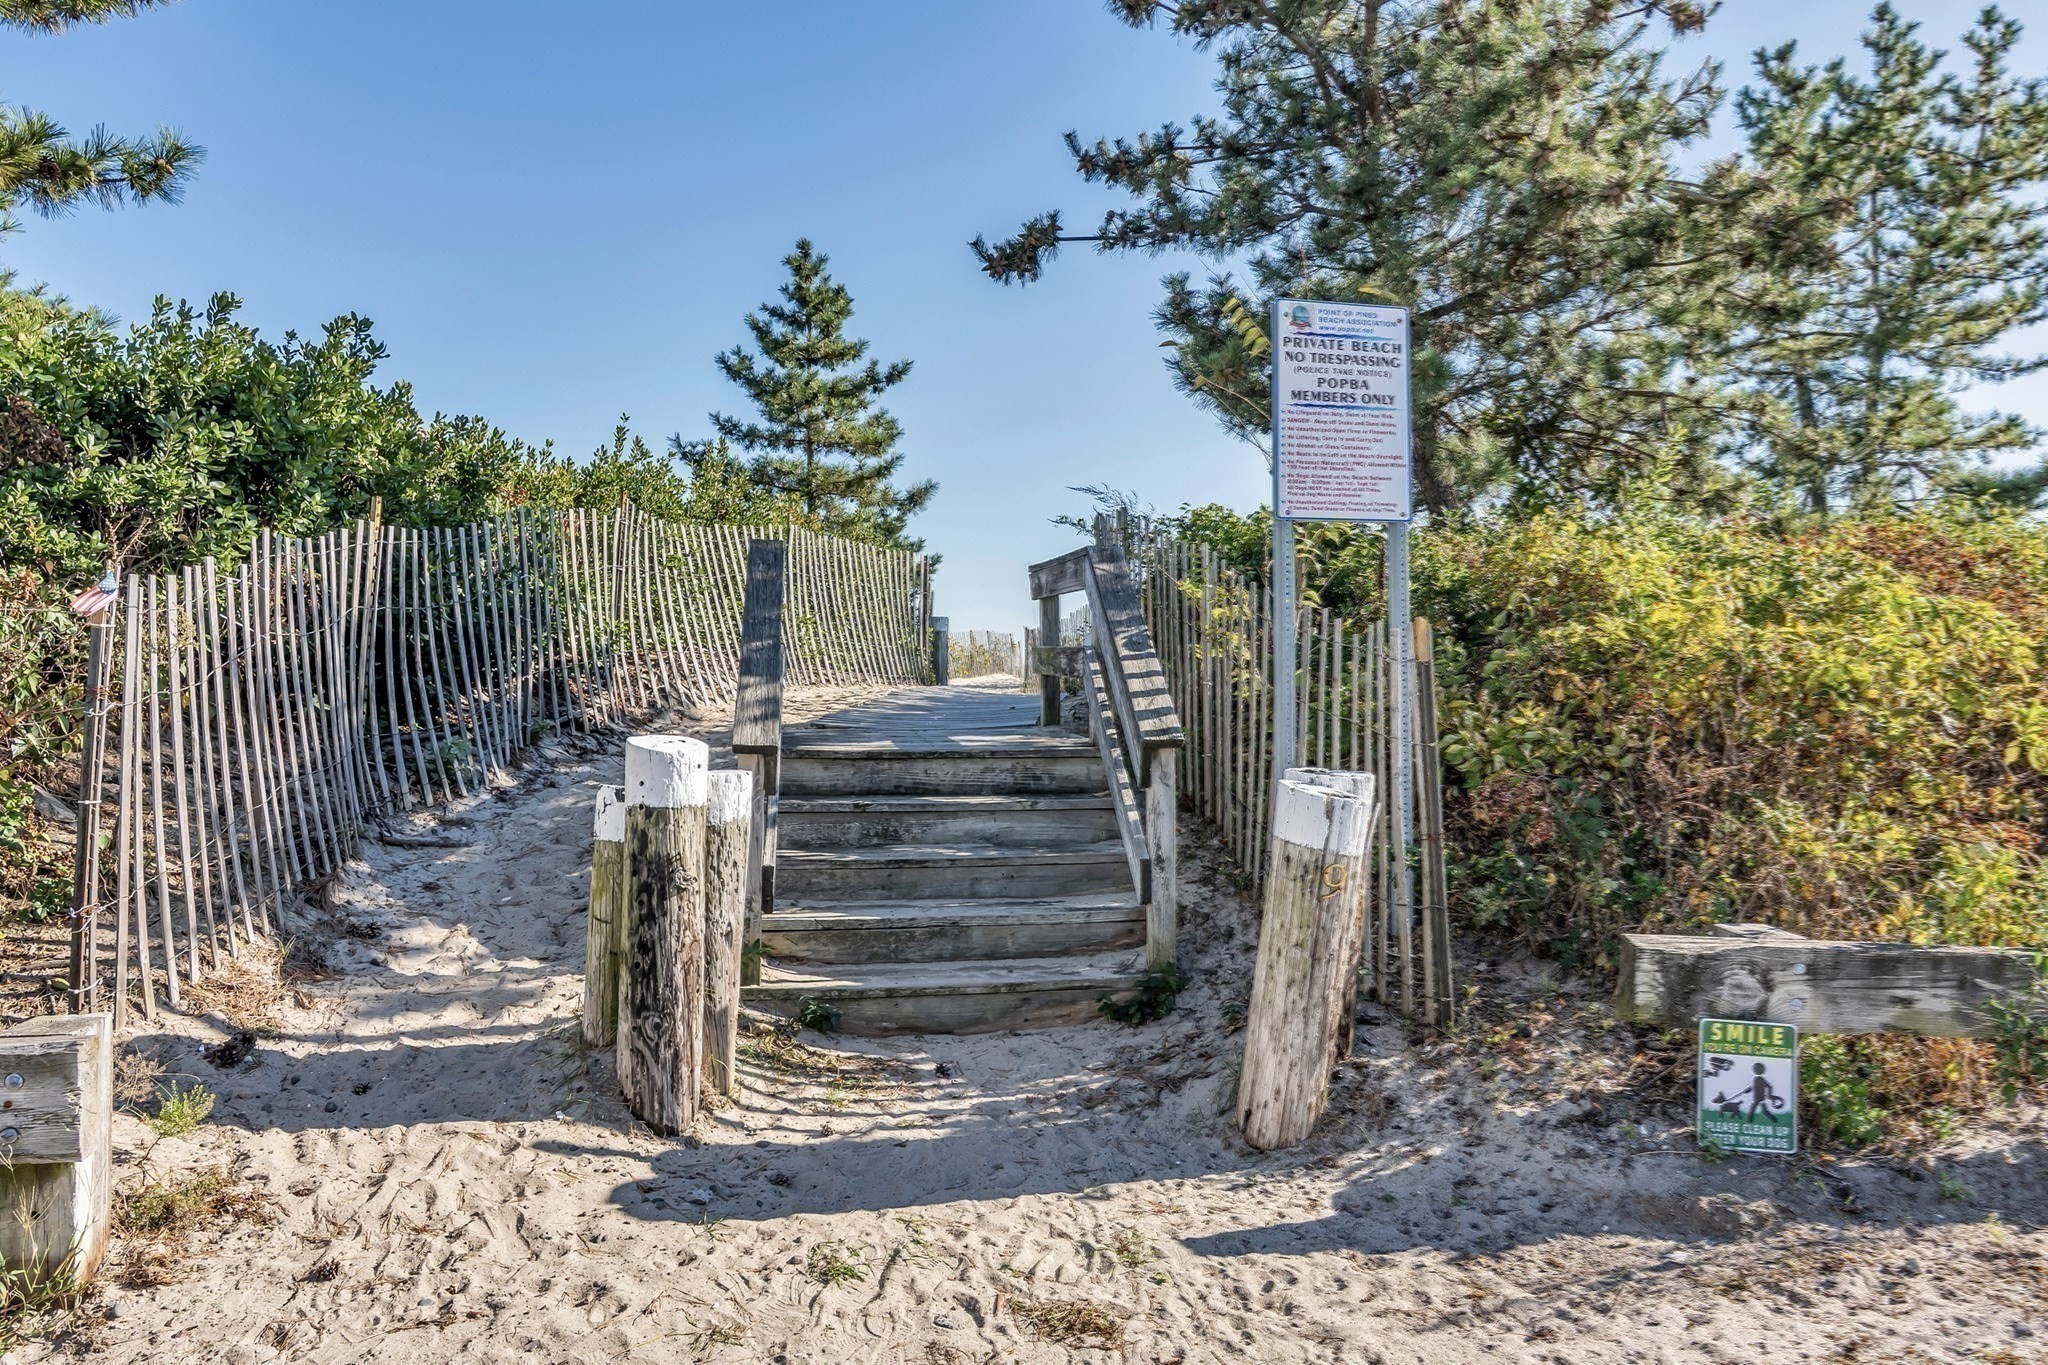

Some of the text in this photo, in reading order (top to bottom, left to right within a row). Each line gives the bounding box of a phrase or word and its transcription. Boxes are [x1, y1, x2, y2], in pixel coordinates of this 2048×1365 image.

[1346, 318, 1397, 328] ASSOCIATION
[1283, 336, 1402, 354] PRIVATE BEACH
[1284, 351, 1400, 368] NO TRESPASSING
[1294, 366, 1328, 374] (POLICE
[1333, 368, 1353, 376] TAKE
[1317, 378, 1368, 390] POPBA
[1290, 390, 1396, 405] MEMBERS ONLY
[1710, 1022, 1784, 1045] SMILE
[1738, 1044, 1752, 1054] ON
[1752, 1045, 1792, 1056] CAMERA
[1704, 1121, 1790, 1137] PLEASE CLEAN UP
[1738, 1135, 1765, 1147] YOUR
[1767, 1138, 1789, 1148] DOG
